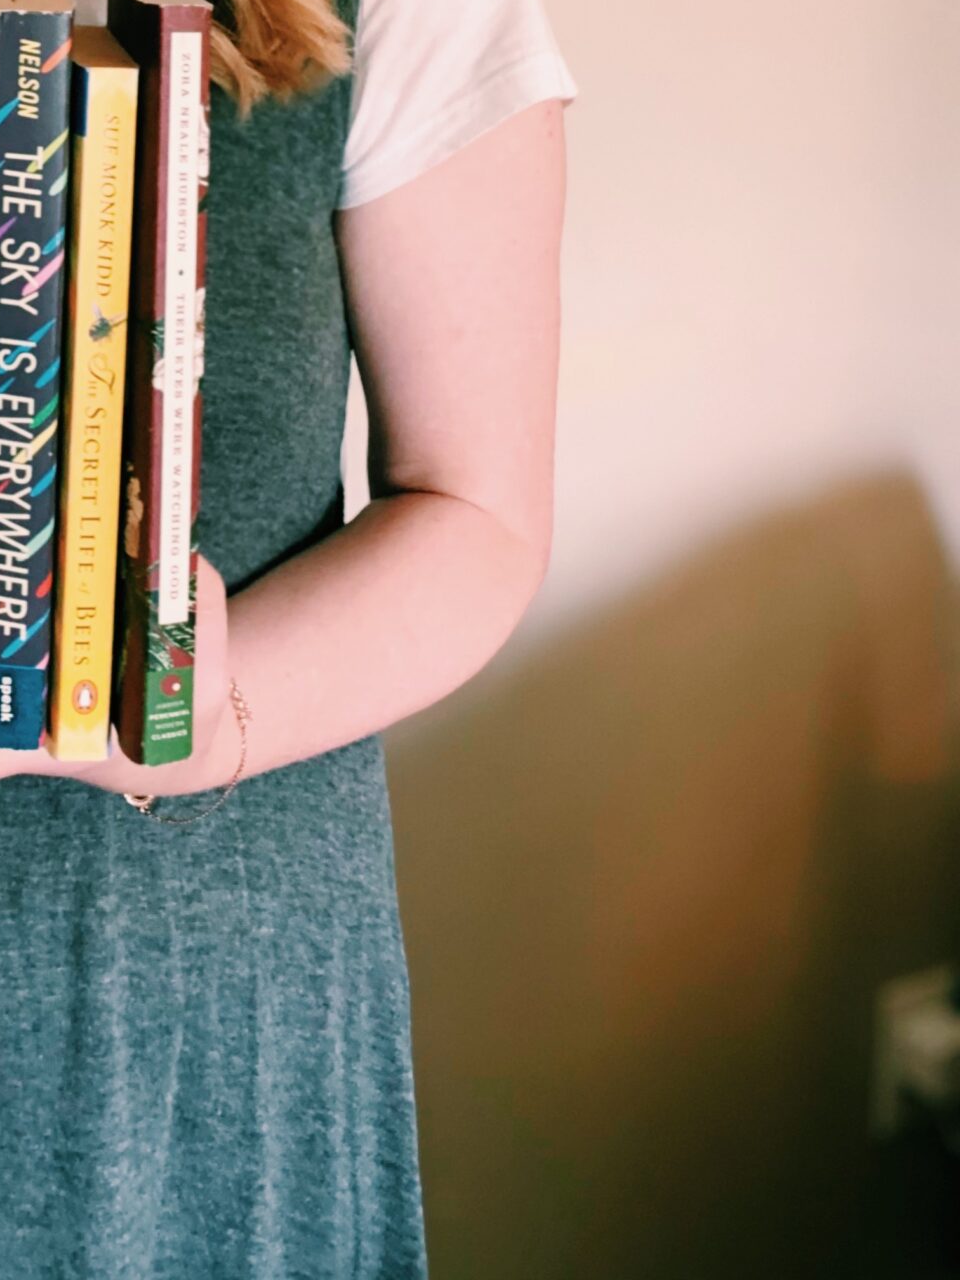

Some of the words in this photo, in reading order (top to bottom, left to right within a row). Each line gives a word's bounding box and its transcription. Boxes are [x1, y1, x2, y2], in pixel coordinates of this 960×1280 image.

[17, 38, 42, 120] NELSON
[181, 53, 191, 97] ZORA
[104, 115, 120, 155] SUE
[179, 107, 189, 163] NEALE
[2, 147, 44, 218] THE
[99, 163, 117, 230] MONK
[177, 172, 188, 253] HURSTON
[0, 239, 40, 316] SKY
[96, 239, 113, 297] KIDD
[175, 294, 185, 347] THEIR
[174, 355, 184, 399] EYES
[173, 408, 183, 456] WERE
[171, 465, 182, 557] WATCHING
[170, 563, 179, 601] GOD
[0, 676, 14, 722] speak
